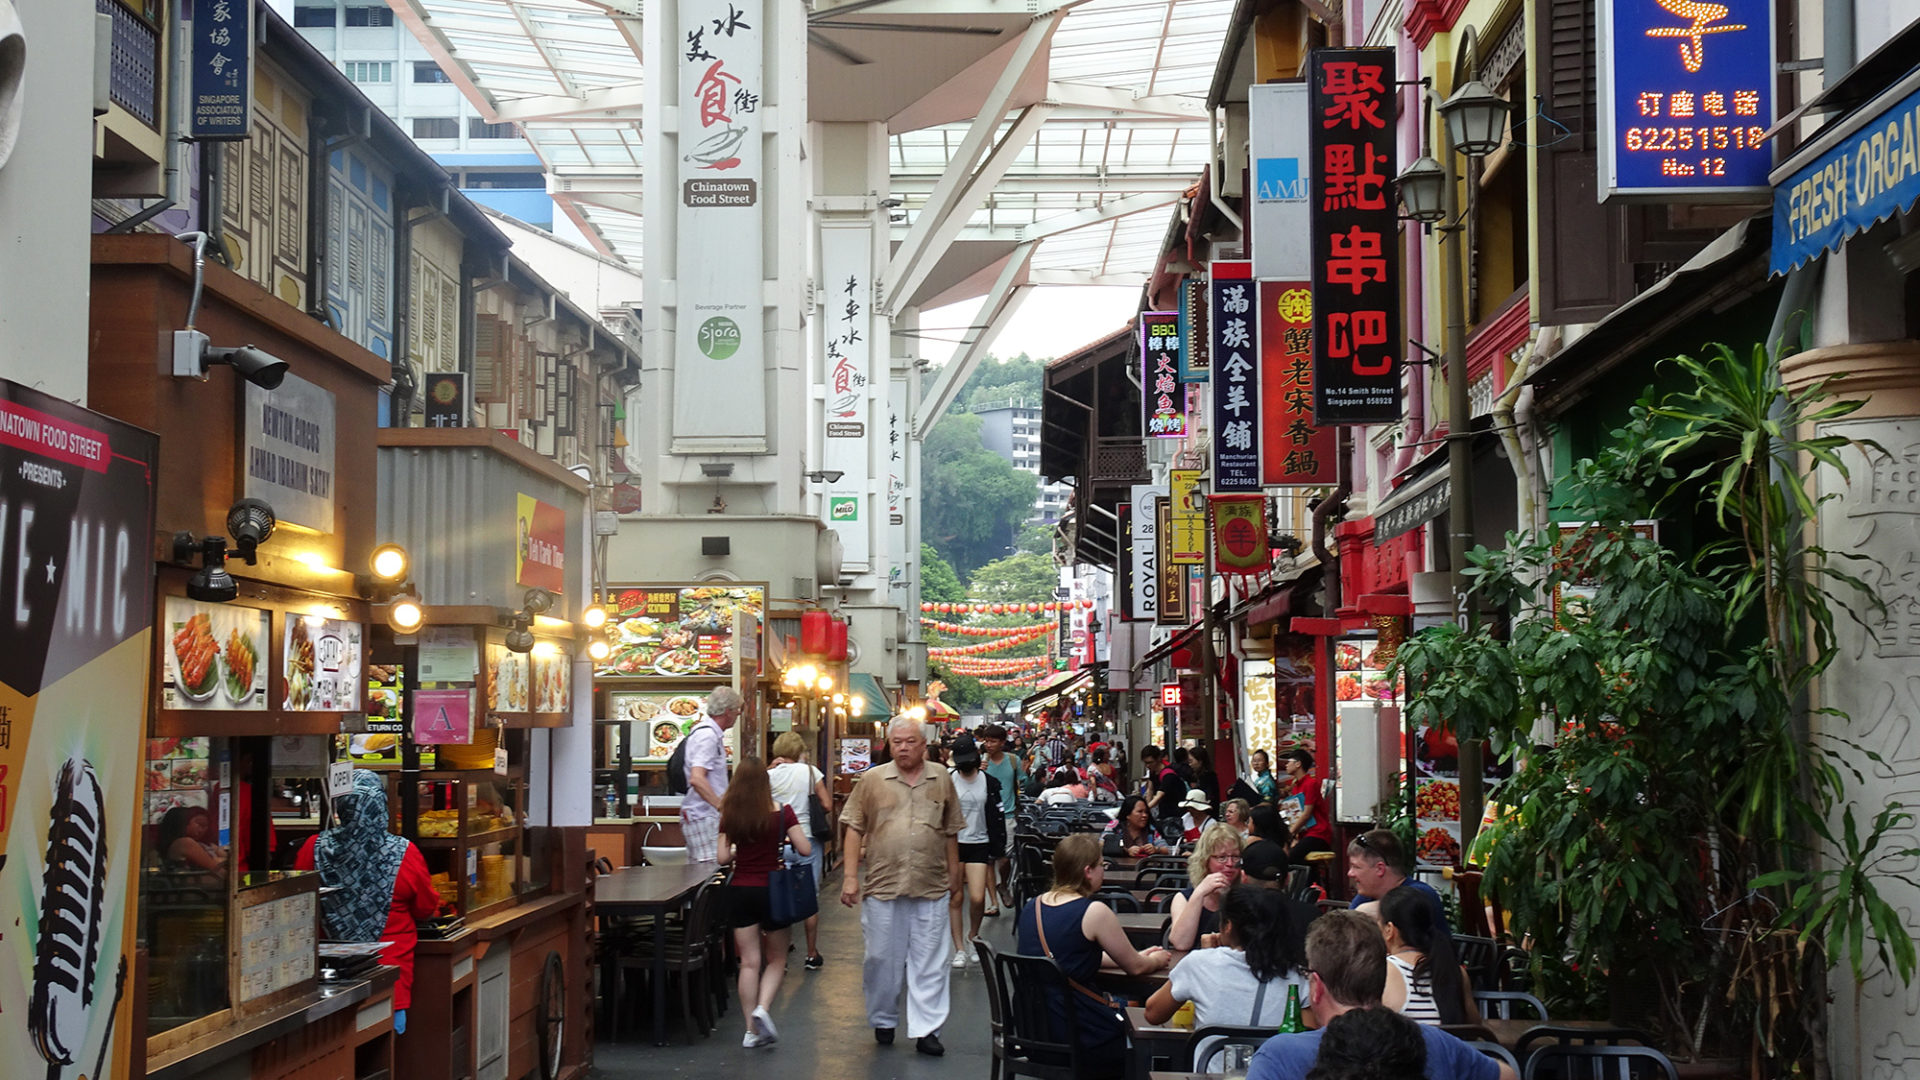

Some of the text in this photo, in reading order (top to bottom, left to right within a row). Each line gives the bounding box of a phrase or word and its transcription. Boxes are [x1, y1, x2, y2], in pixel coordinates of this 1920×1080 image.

[712, 3, 751, 37] 水
[196, 105, 243, 116] ASSOCIATION
[199, 94, 240, 105] SINGAPORE
[197, 116, 241, 126] OF WRITERS
[1701, 157, 1726, 175] 12
[690, 182, 750, 193] Chinatown
[1256, 177, 1309, 199] AMJ
[690, 194, 750, 205] Food Street
[1788, 154, 1848, 245] FRESH
[1321, 61, 1393, 377] 聚點串吧
[701, 323, 739, 356] sjora
[1151, 324, 1177, 336] BBQ
[1327, 397, 1363, 406] Singapore
[1348, 387, 1369, 395] Smith
[1371, 387, 1394, 395] Street
[0, 410, 102, 461] NATOWN FOOD STREET
[263, 404, 320, 453] NEWTON CIRCUS
[22, 461, 63, 488] PRESENTS
[310, 466, 330, 499] SATAY
[834, 506, 854, 514] MILO
[1142, 524, 1154, 534] 28
[66, 519, 130, 639] MIC
[1142, 544, 1155, 612] ROYAL
[428, 704, 455, 730] A
